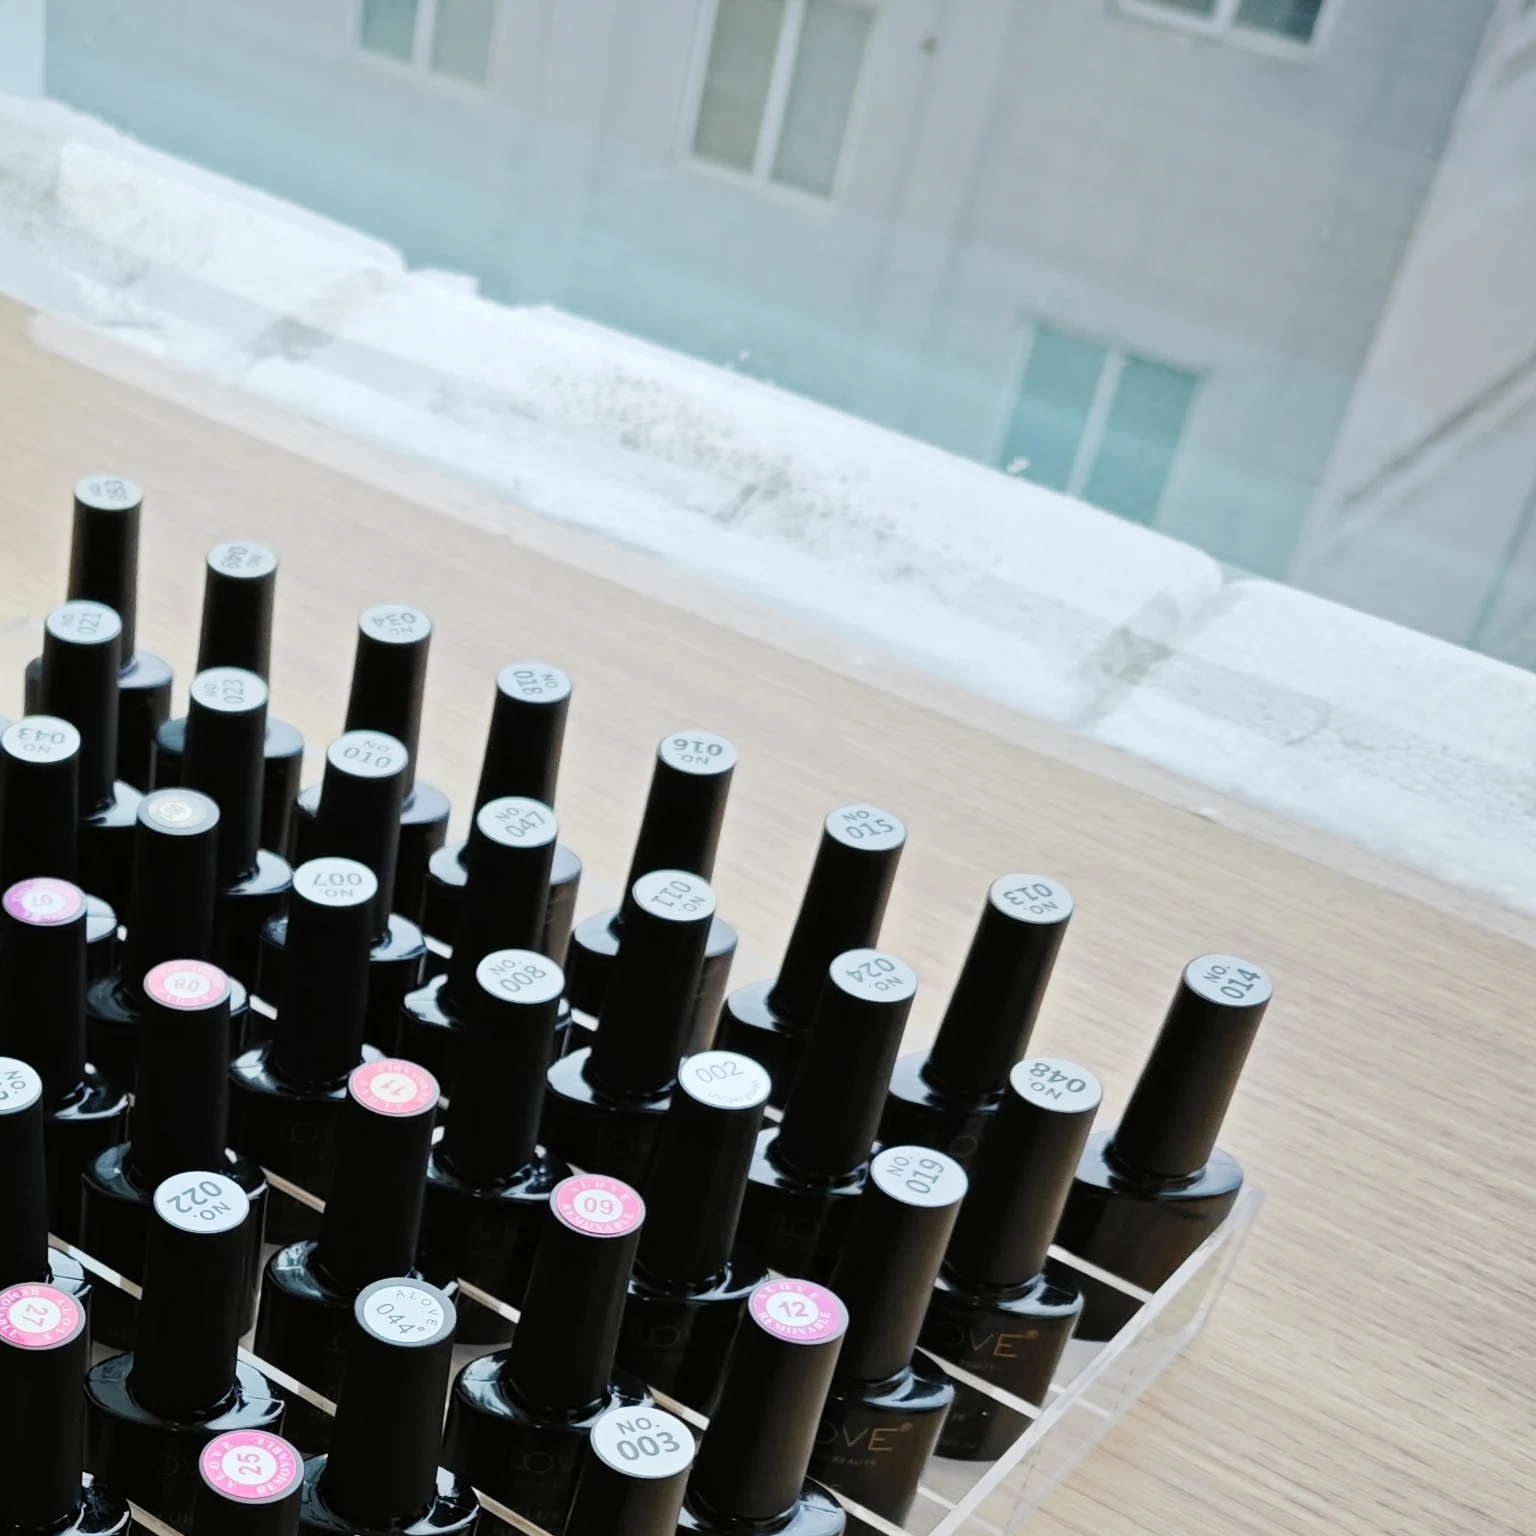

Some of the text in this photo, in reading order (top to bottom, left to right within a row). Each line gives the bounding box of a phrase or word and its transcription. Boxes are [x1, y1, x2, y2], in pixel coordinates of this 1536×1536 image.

[17, 728, 66, 745] 043
[343, 747, 392, 768] 010
[673, 739, 723, 756] 016
[504, 811, 546, 837] 047
[845, 820, 894, 839] 015
[312, 873, 362, 886] 007
[319, 888, 354, 898] NO.
[651, 880, 692, 909] 011
[1003, 884, 1053, 908] 013
[679, 895, 706, 913] NO.
[1024, 900, 1059, 914] NO.
[487, 958, 524, 976] NO.
[846, 958, 896, 983] 024
[1203, 964, 1231, 984] NO.
[499, 965, 547, 992] 008
[868, 975, 903, 992] NO.
[1219, 967, 1261, 999] 014
[5, 1070, 26, 1095] NO.
[695, 1062, 743, 1084] 002
[1029, 1062, 1086, 1093] 048
[379, 1078, 407, 1094] 11
[1030, 1081, 1062, 1100] NO.
[886, 1155, 914, 1176] NO.
[906, 1159, 945, 1193] 019
[167, 1180, 222, 1213] 022
[568, 1182, 629, 1200] ALOVE
[193, 1201, 231, 1221] NO.
[583, 1198, 612, 1213] 09
[562, 1203, 633, 1233] REMOVABLE
[755, 1283, 821, 1304] ALOVE
[25, 1303, 48, 1327] 27
[42, 1298, 73, 1341] ALOVE
[376, 1303, 414, 1335] 044
[778, 1302, 808, 1318] 12
[763, 1311, 831, 1338] REMOVABLE
[616, 1418, 660, 1435] NO.
[616, 1434, 680, 1461] 003
[209, 1440, 236, 1490] ALOVE
[238, 1454, 261, 1475] 25
[253, 1436, 290, 1495] REMOVABLE
